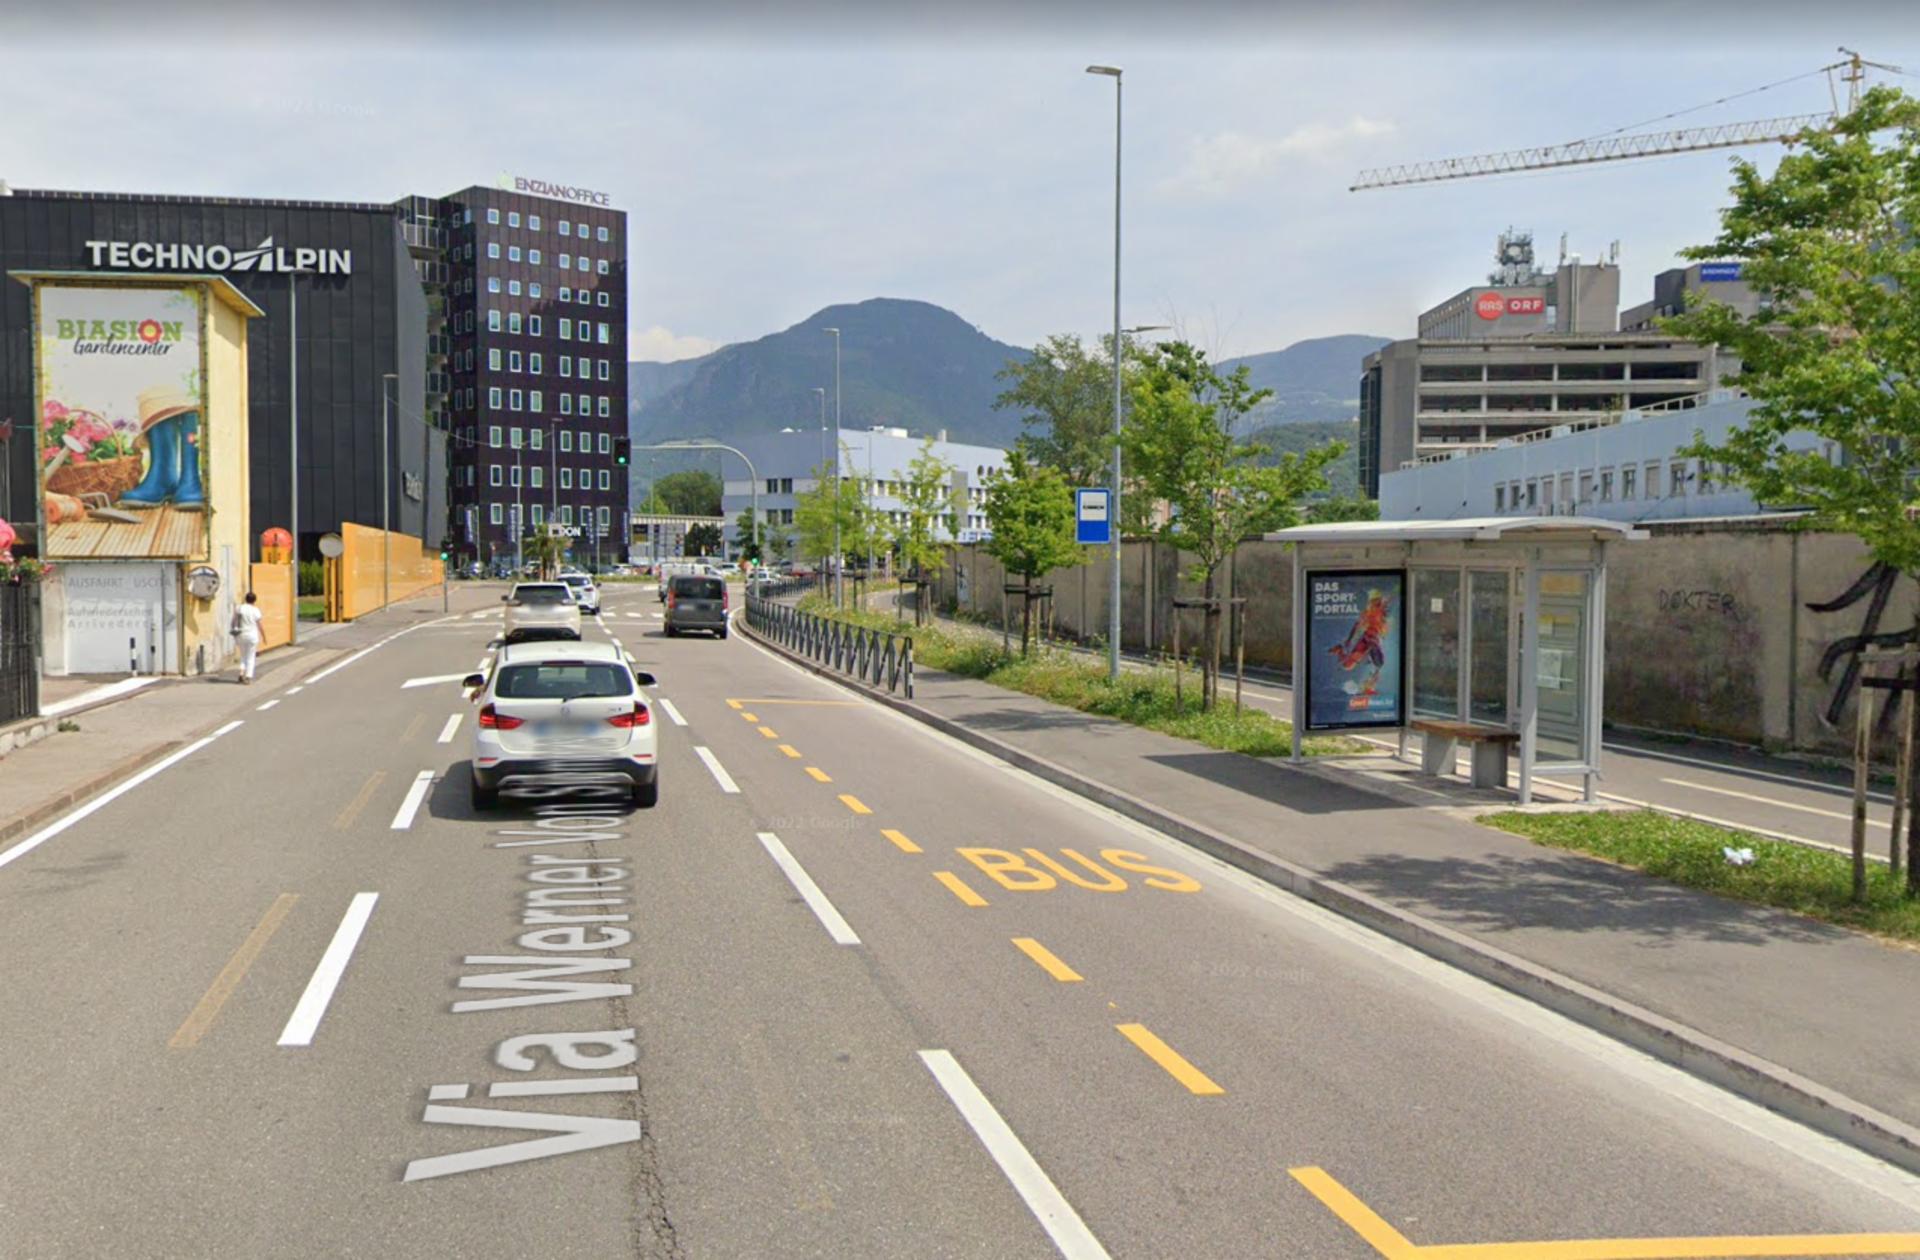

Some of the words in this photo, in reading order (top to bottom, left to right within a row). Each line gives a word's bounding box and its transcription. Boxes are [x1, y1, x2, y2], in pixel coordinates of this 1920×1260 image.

[1509, 300, 1543, 312] ORF
[56, 318, 184, 345] BIASION
[72, 333, 173, 355] Gardencenter
[1315, 582, 1339, 592] DAS
[1315, 593, 1357, 603] SPORT-
[1315, 604, 1359, 614] PORTAL
[954, 847, 1203, 892] BUS
